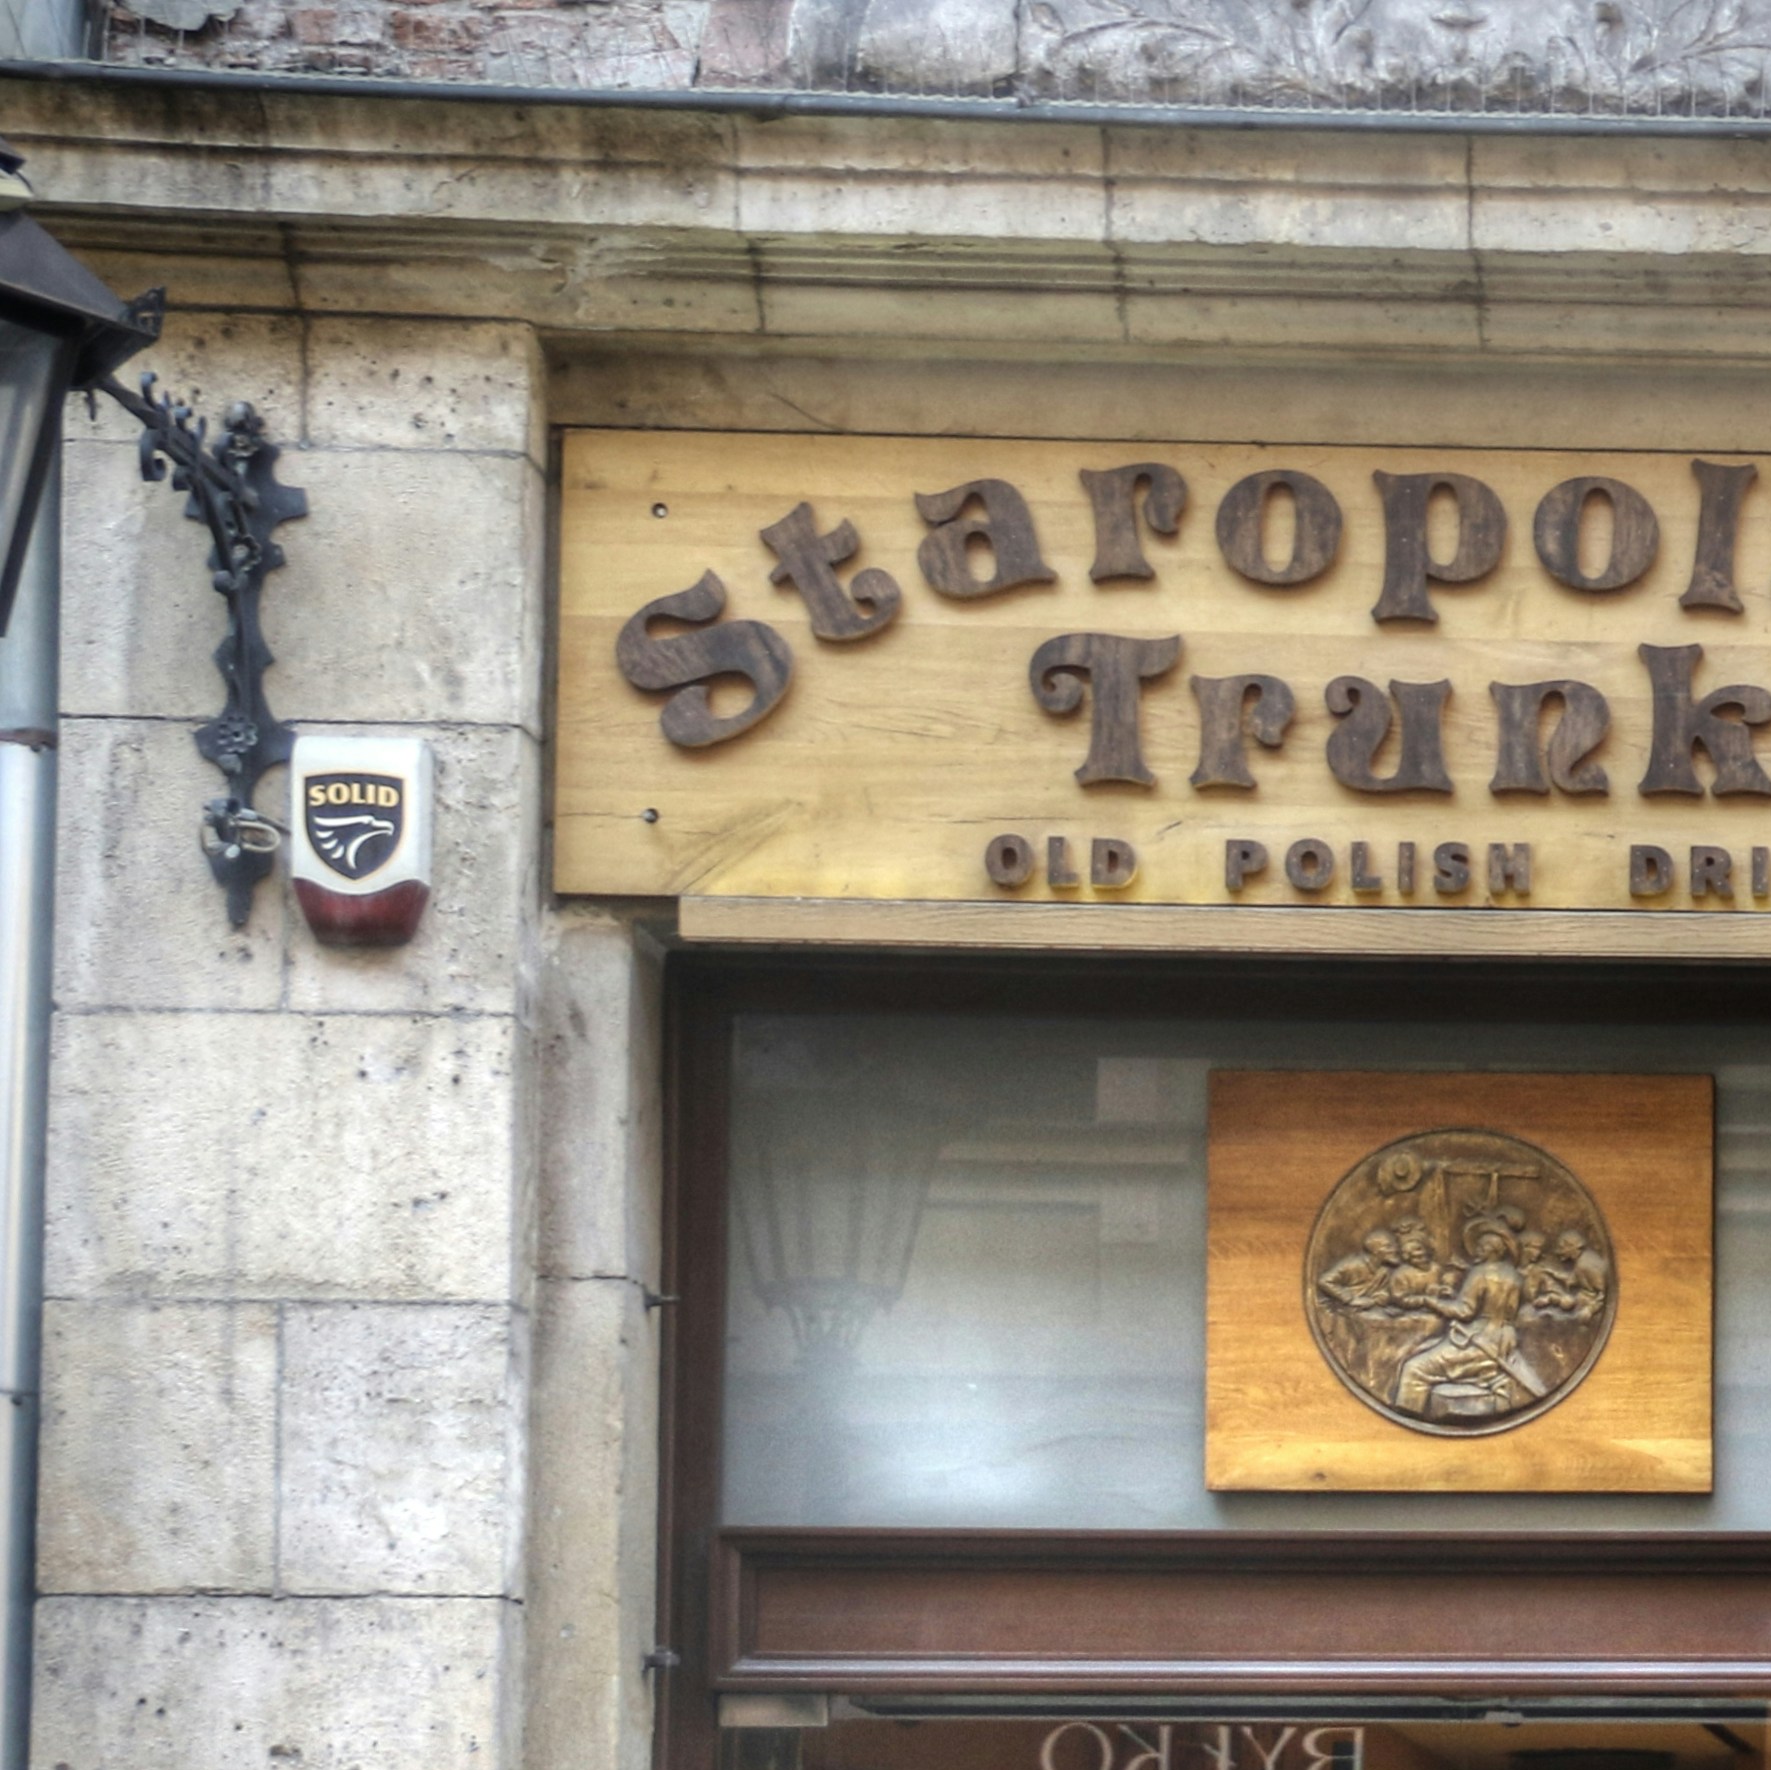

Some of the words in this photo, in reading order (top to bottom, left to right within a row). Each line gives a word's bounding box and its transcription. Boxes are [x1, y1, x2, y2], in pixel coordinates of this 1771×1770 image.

[308, 783, 400, 807] SOLID
[984, 833, 1140, 890] OLD
[1224, 838, 1533, 897] POLISH
